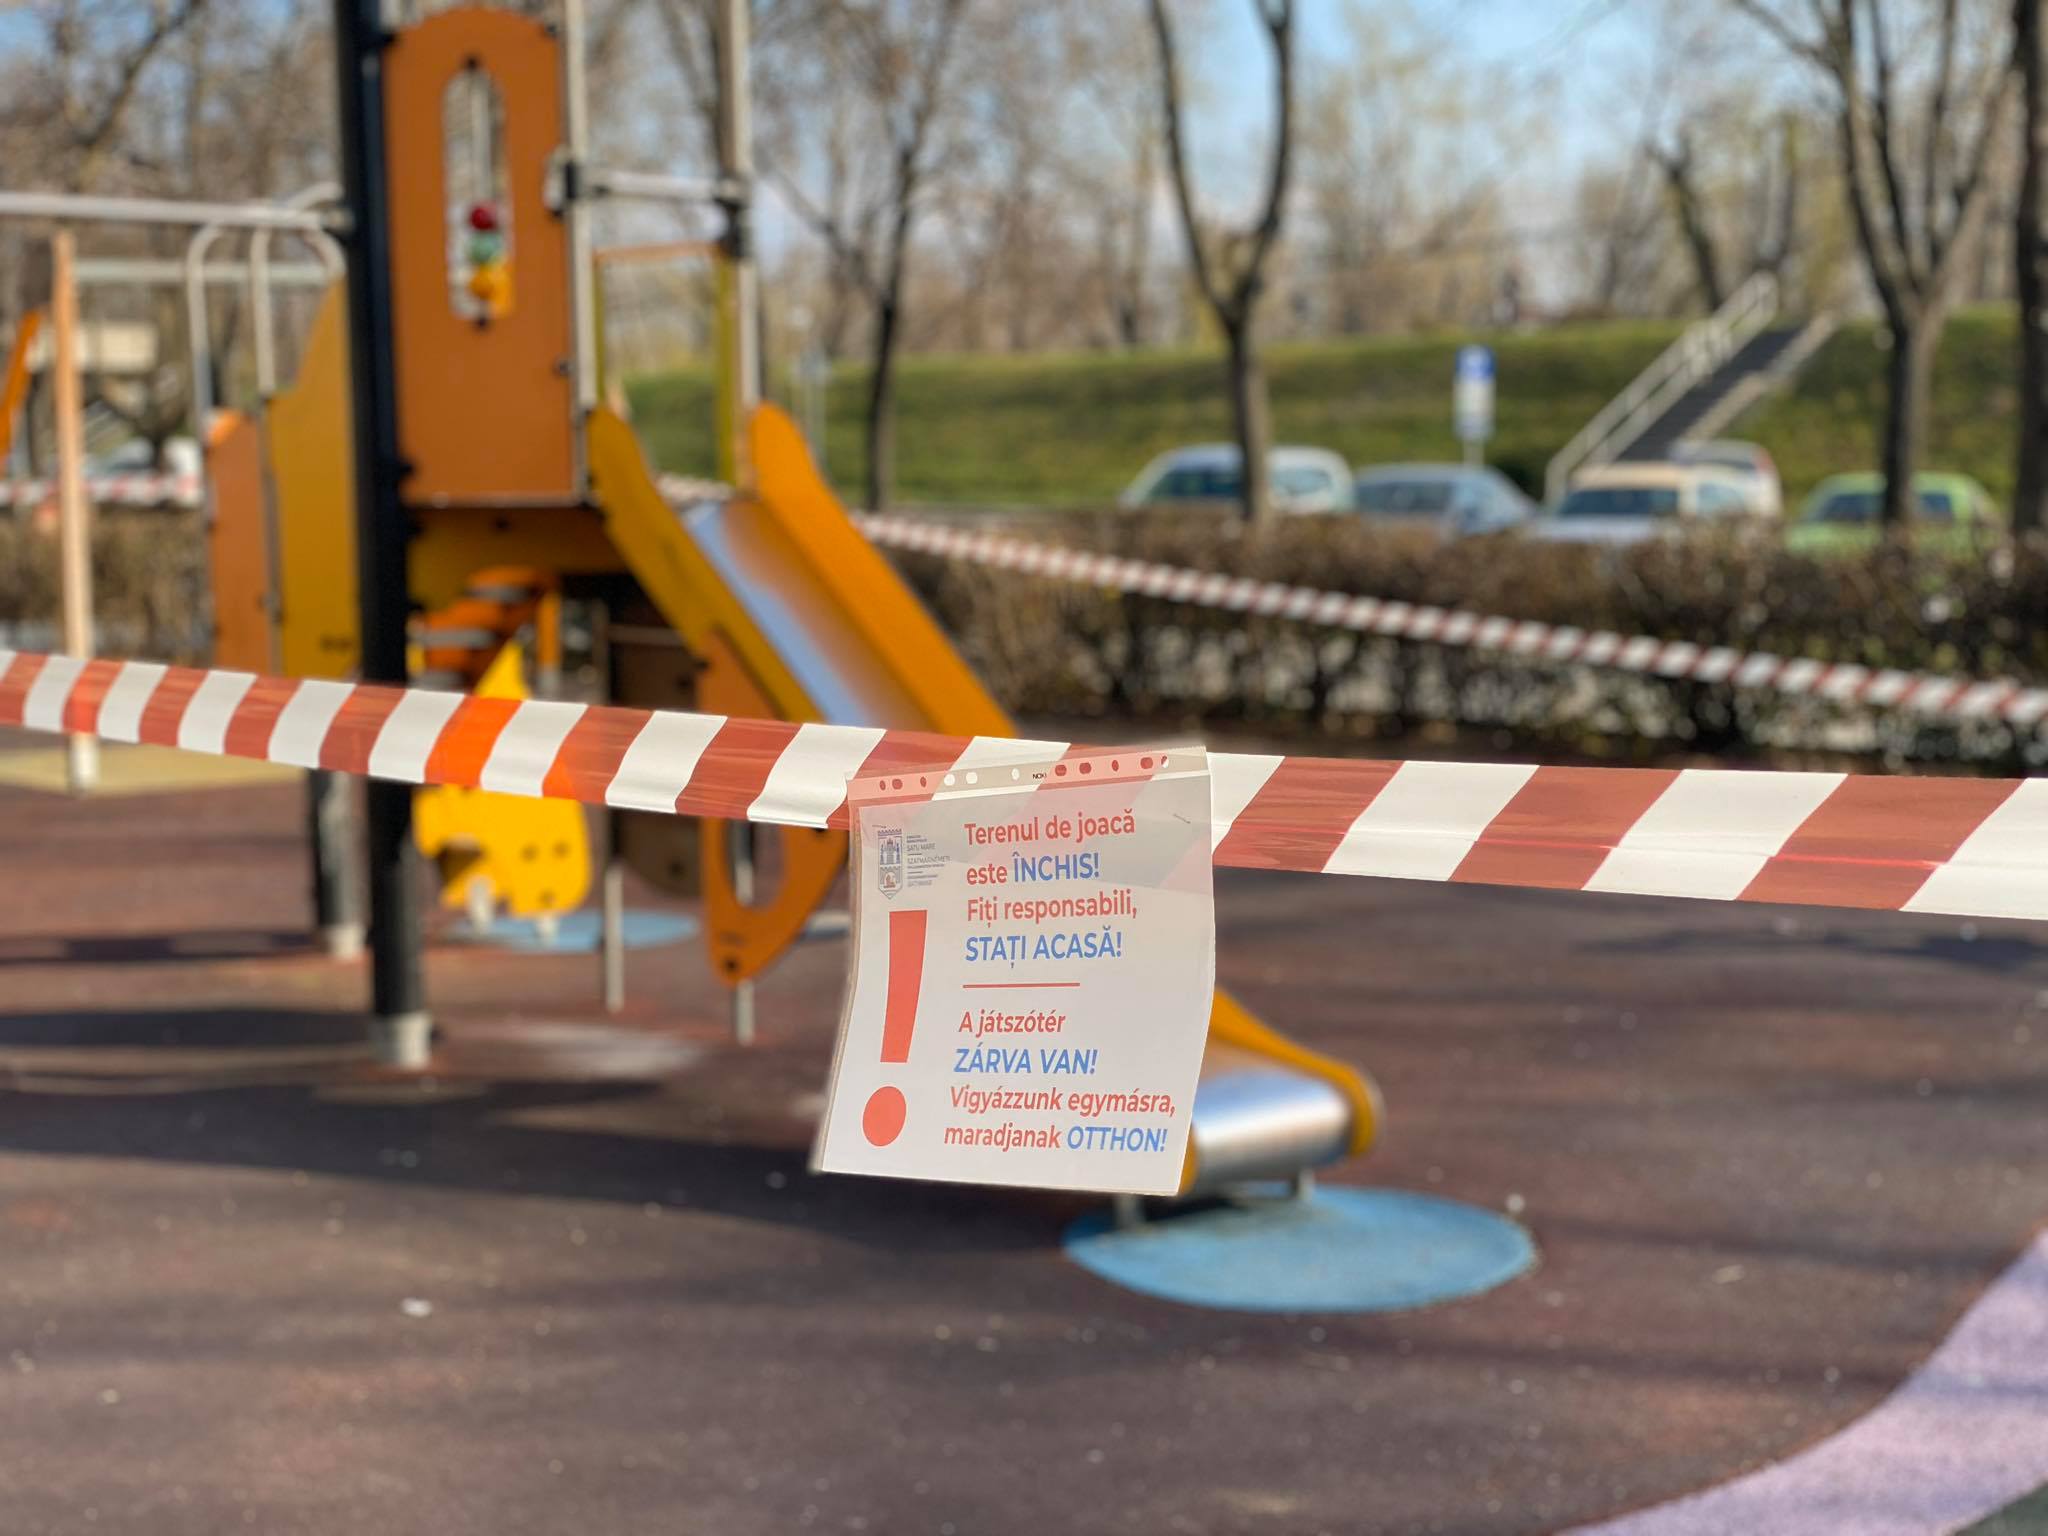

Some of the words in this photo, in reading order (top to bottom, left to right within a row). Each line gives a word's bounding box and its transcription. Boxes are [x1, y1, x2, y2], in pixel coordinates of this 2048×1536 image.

[964, 816, 1039, 846] Terenul
[1045, 815, 1072, 840] de
[1076, 808, 1136, 843] joacă
[966, 863, 1008, 885] este
[1012, 851, 1100, 882] ÎNCHIS!
[967, 896, 998, 928] Fiți
[1004, 889, 1138, 924] responsabili,
[965, 935, 1026, 969] STAȚI
[1033, 925, 1122, 960] ACASĂ!
[958, 1011, 973, 1033] A
[975, 1009, 1066, 1038] játszótér
[953, 1041, 1032, 1073] ZÁRVA
[1040, 1049, 1098, 1074] VAN!
[1067, 1088, 1176, 1118] egymásra,
[944, 1122, 1062, 1152] maradjanak
[1067, 1126, 1168, 1152] OTTHON!
